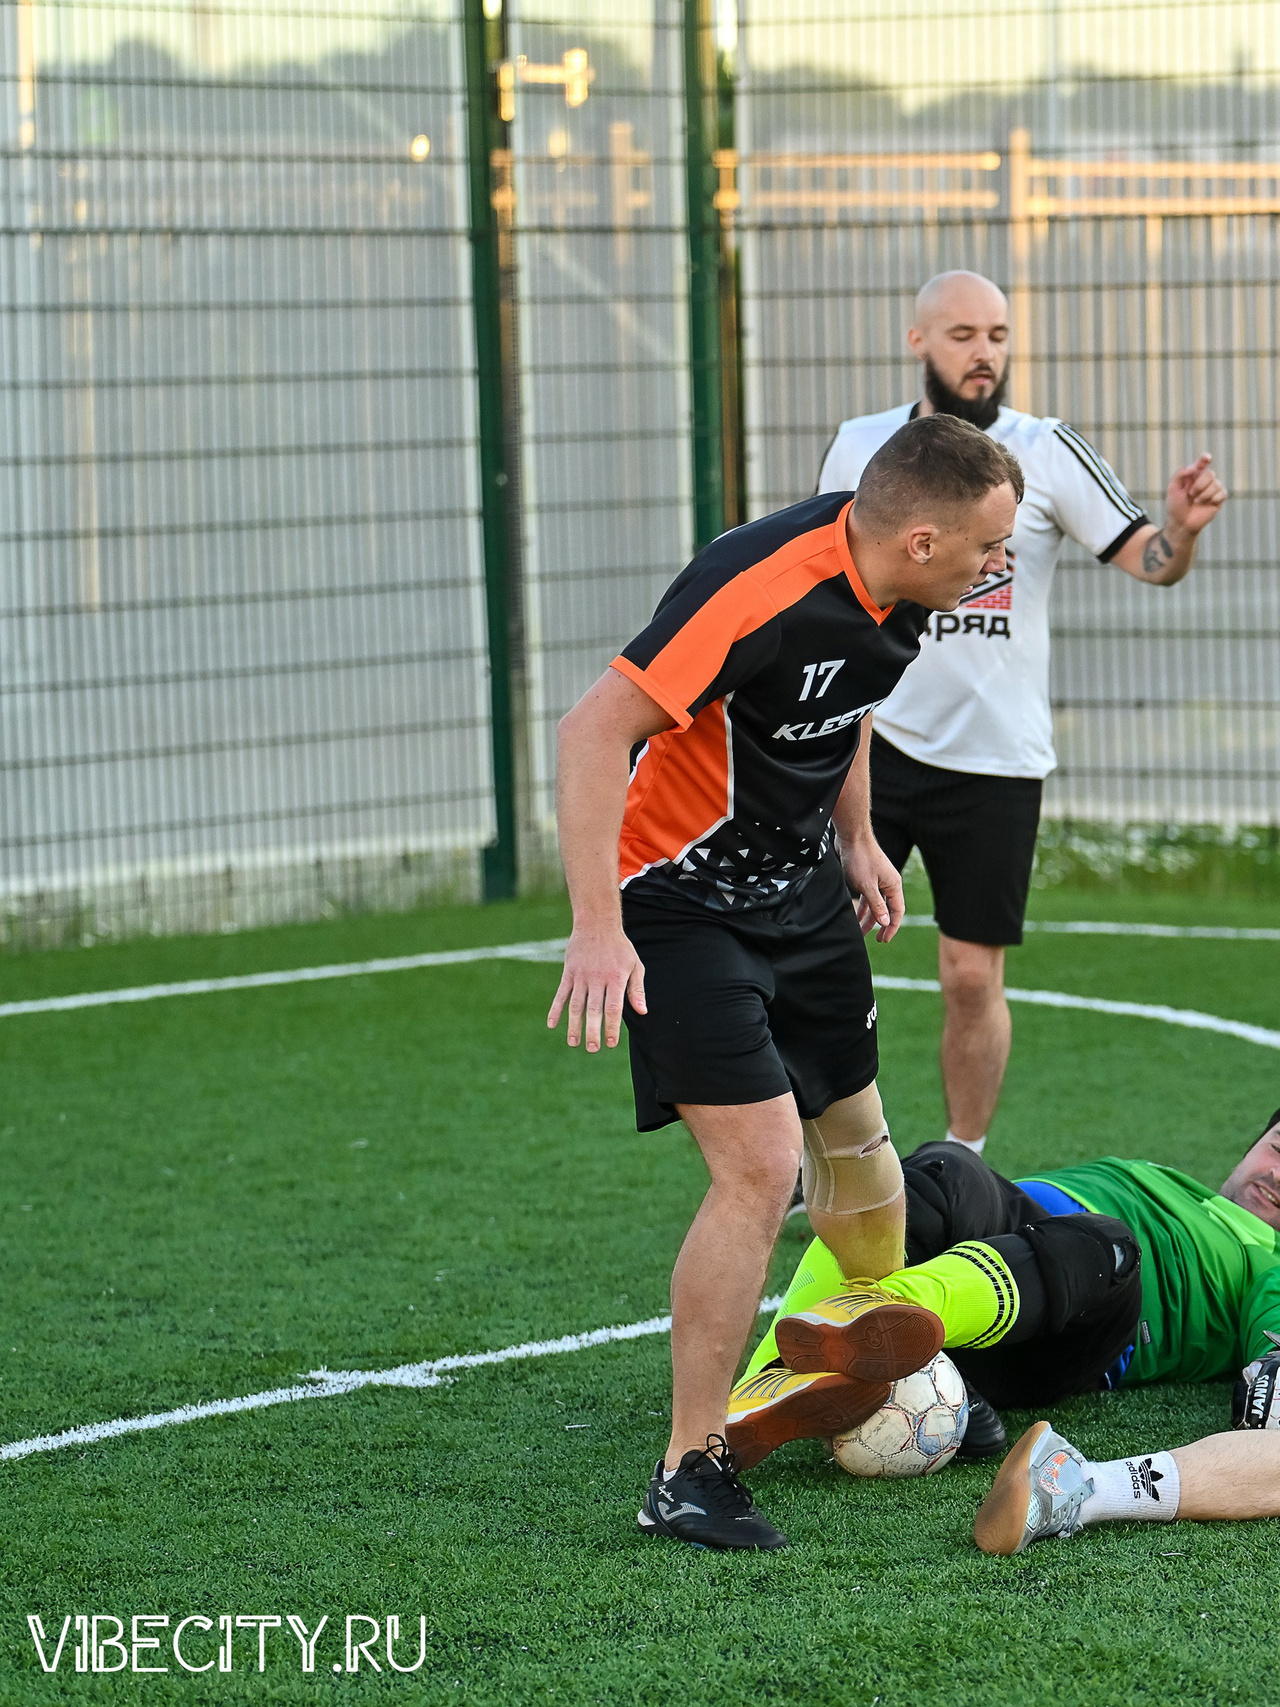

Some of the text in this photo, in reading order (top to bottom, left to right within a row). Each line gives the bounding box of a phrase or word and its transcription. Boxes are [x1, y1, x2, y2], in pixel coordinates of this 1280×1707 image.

[924, 614, 1011, 642] ряд
[798, 659, 847, 701] 17
[1251, 1374, 1270, 1420] JANUS
[1125, 1460, 1143, 1499] adidas
